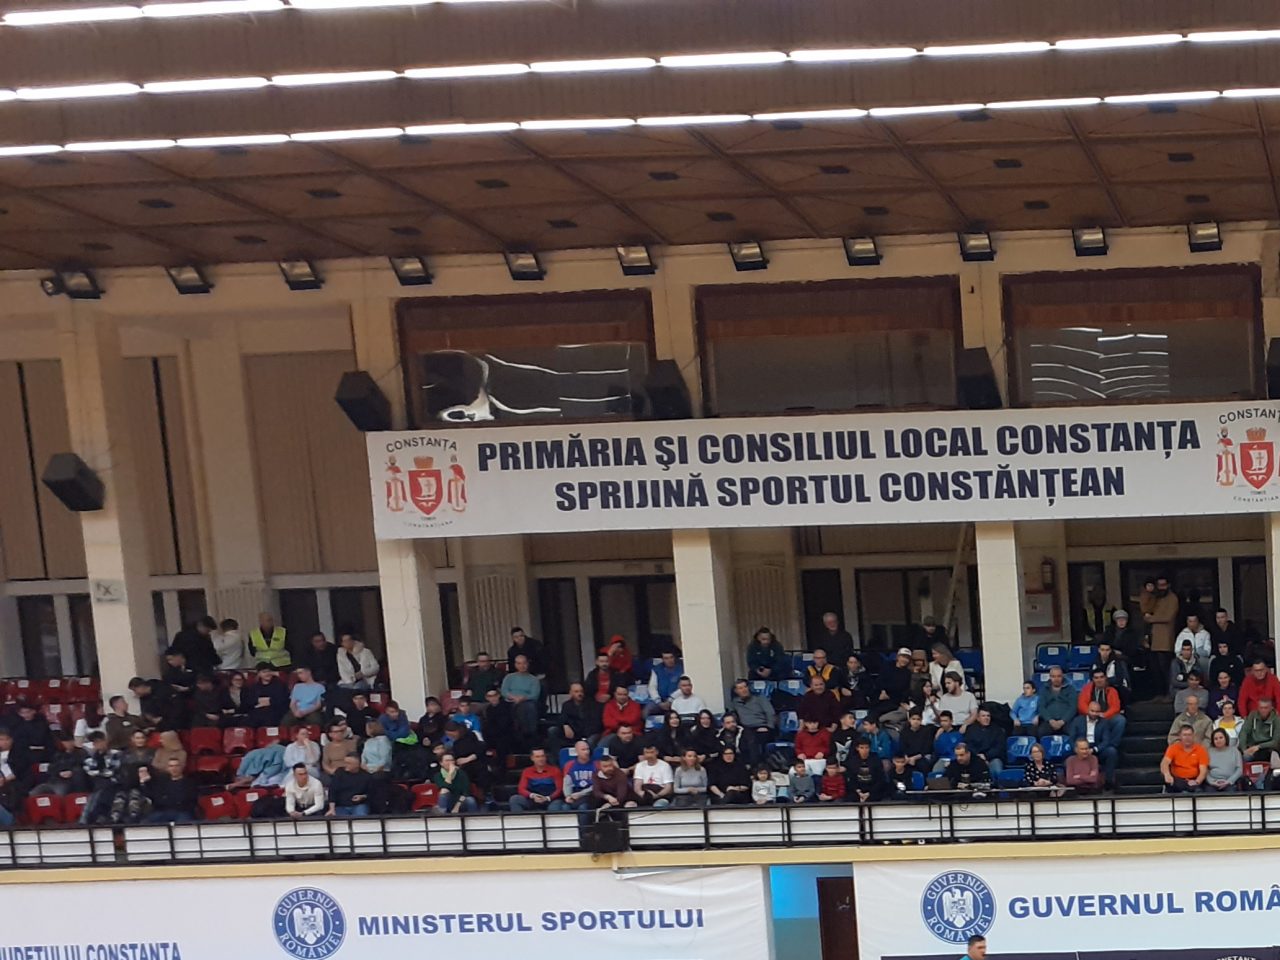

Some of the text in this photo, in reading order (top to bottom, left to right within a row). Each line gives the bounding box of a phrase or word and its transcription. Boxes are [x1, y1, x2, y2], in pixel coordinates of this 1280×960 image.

[478, 433, 647, 471] PRIMĂRIA
[698, 430, 876, 464] CONSILIUL
[884, 426, 988, 459] LOCAL
[996, 419, 1201, 459] CONSTANȚA
[555, 472, 709, 511] SPRIJINĂ
[717, 474, 871, 507] SPORTUL
[926, 873, 988, 899] GUVERNUL
[278, 890, 337, 916] GUVERNUL
[1008, 892, 1184, 919] GUVERNUL
[358, 908, 704, 936] MINISTERUL SPORTULUI
